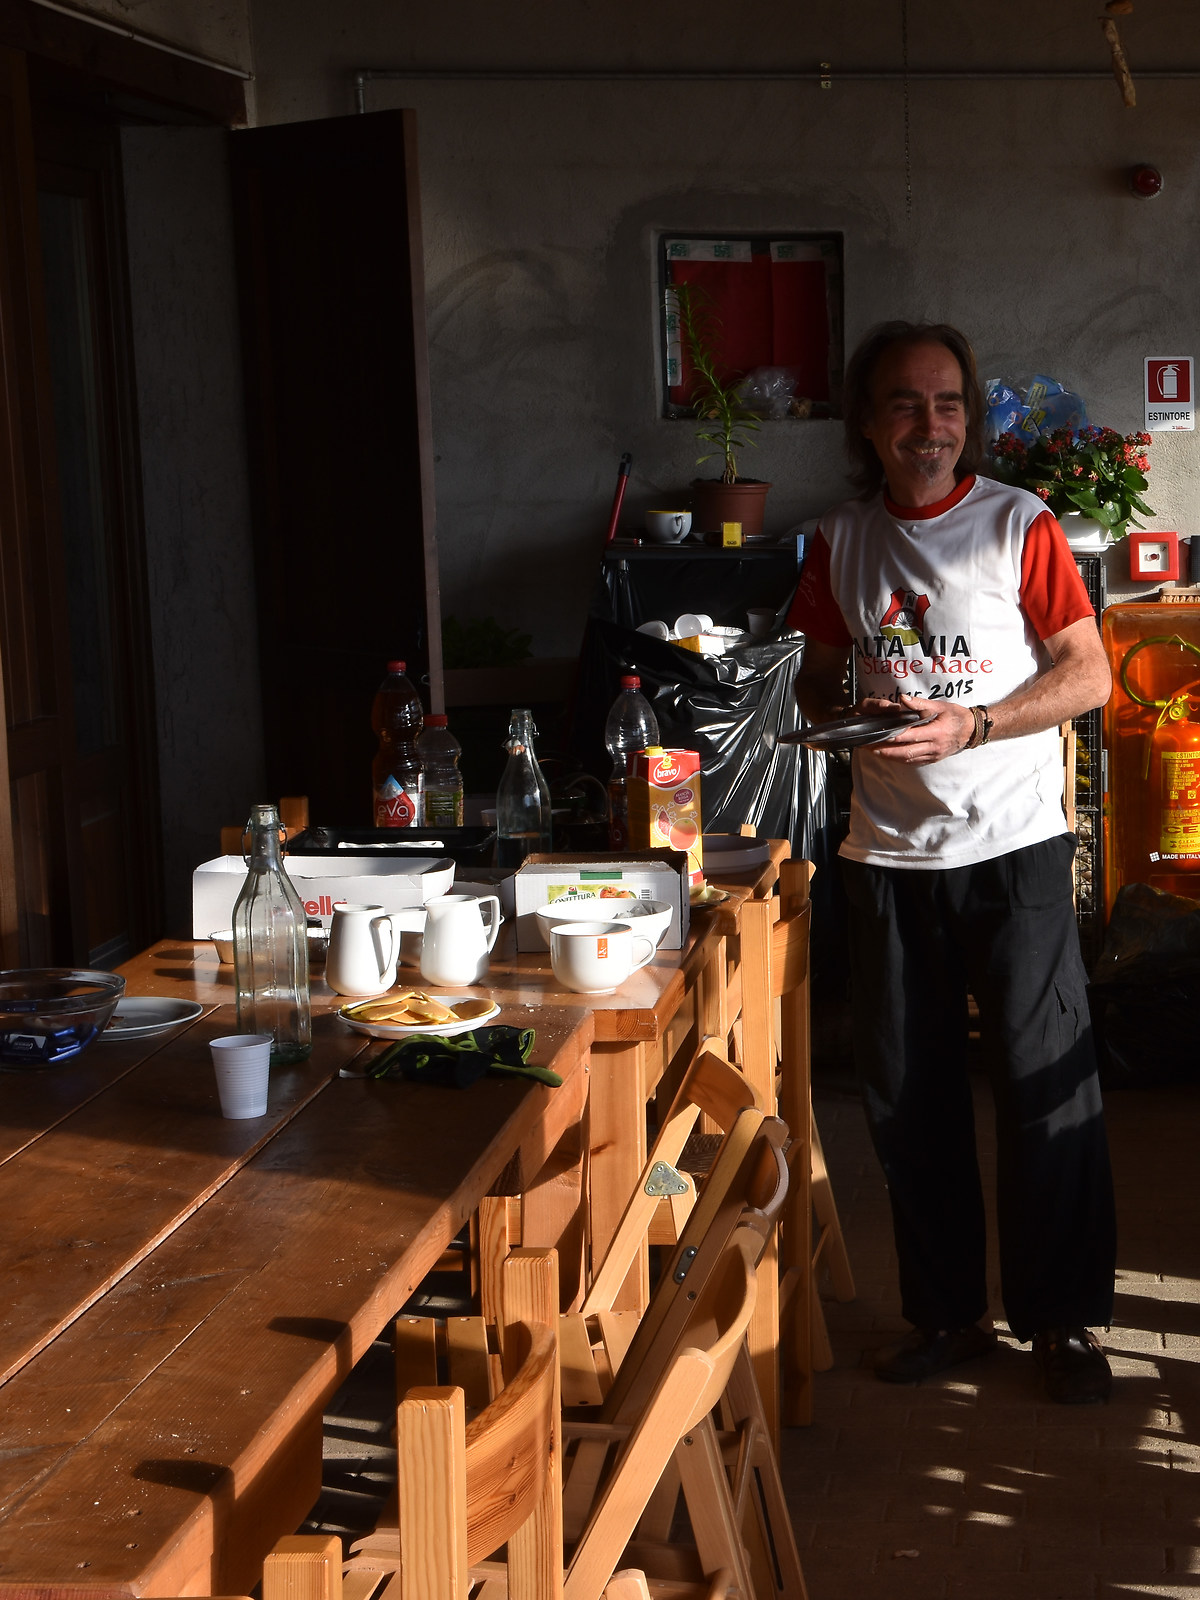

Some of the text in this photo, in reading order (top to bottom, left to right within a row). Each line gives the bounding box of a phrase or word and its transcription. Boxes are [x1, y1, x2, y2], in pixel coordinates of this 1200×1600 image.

[1148, 411, 1190, 421] ESTINTORE
[854, 634, 971, 658] ALTA VIA
[863, 655, 994, 679] Stage Race
[928, 679, 975, 700] 2015
[657, 768, 677, 777] bravo
[300, 895, 348, 916] ell
